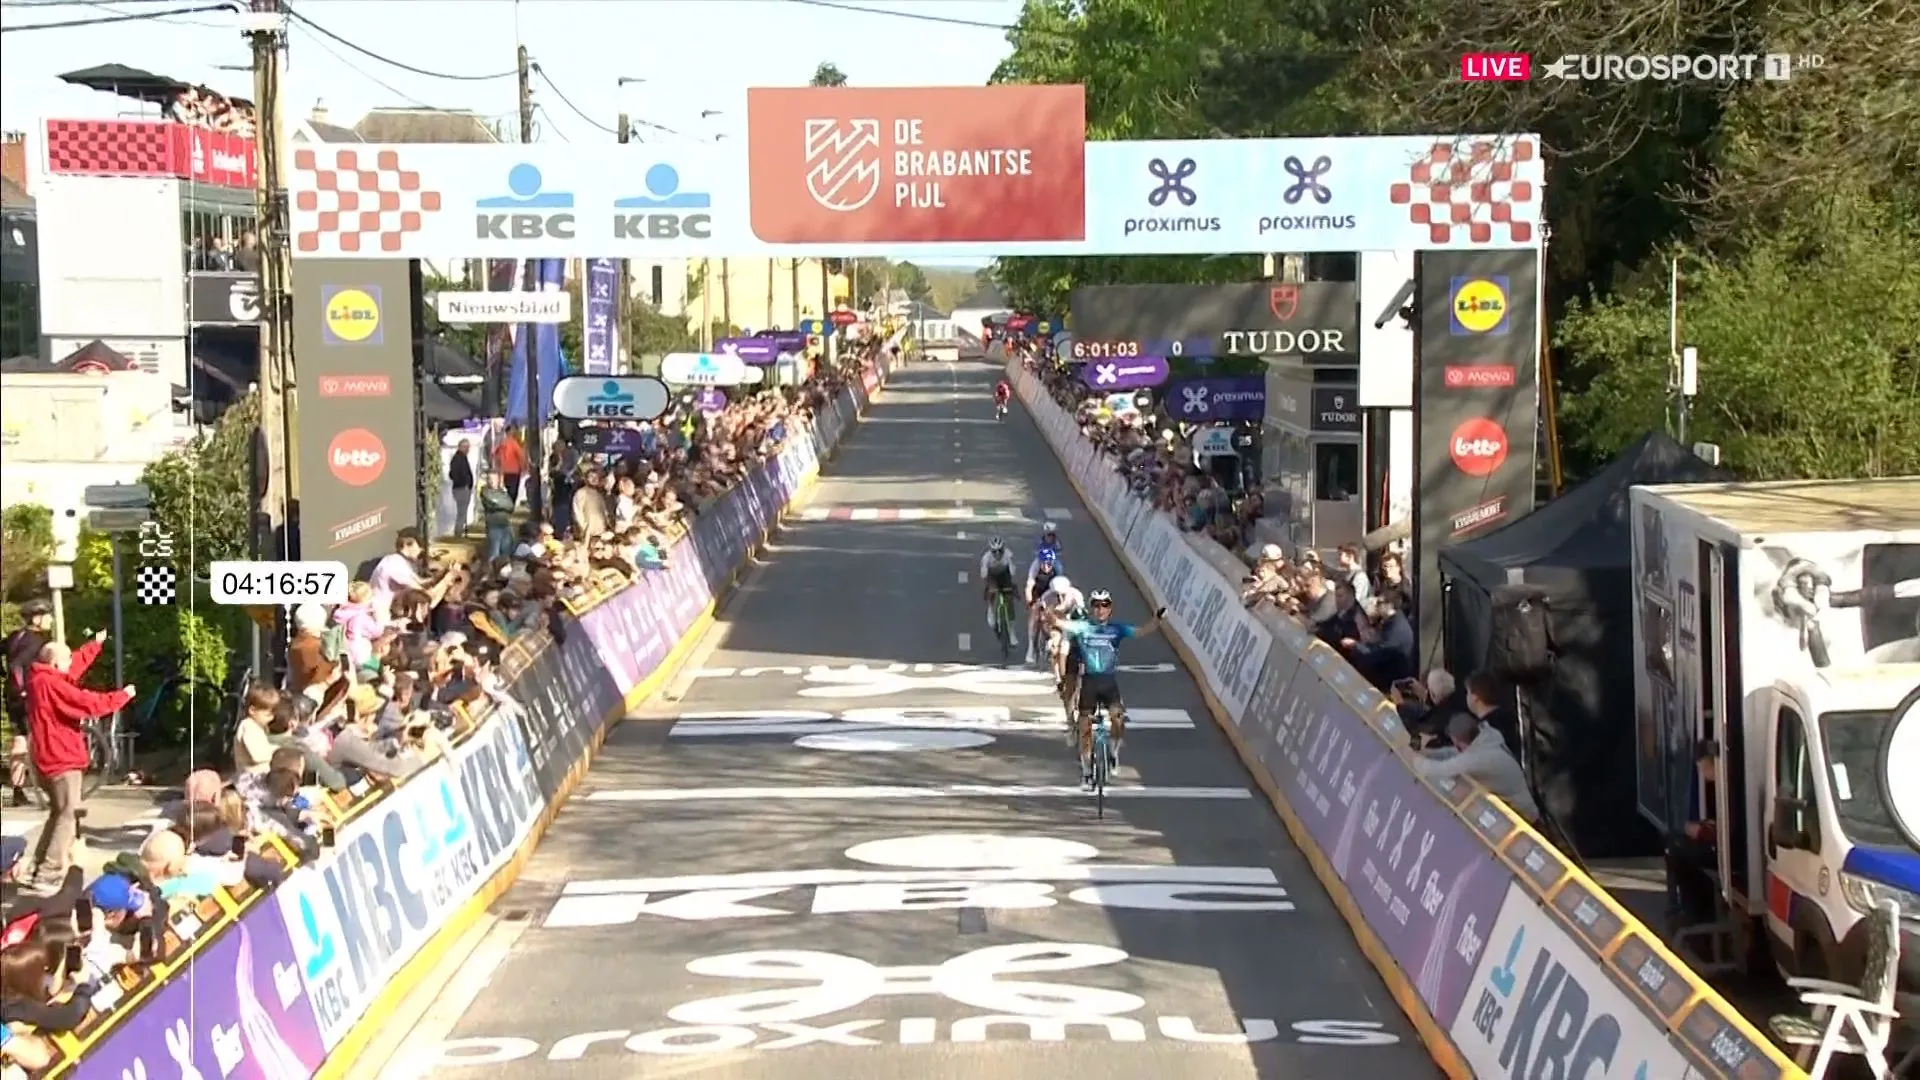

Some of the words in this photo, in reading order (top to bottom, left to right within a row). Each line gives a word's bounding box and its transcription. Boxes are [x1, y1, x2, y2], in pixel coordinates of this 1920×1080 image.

[894, 119, 923, 145] DE
[894, 149, 1033, 176] BRABANTSE
[895, 182, 946, 208] PIJL
[476, 213, 575, 239] KBC
[613, 213, 711, 239] KBC
[1124, 217, 1221, 237] proximus
[1258, 214, 1357, 235] proximus
[449, 301, 561, 316] Nieuwsblad
[1074, 342, 1138, 357] 6:01:03
[1172, 341, 1183, 356] 0
[1223, 329, 1346, 353] TUDOR
[586, 404, 635, 416] KBC
[1320, 412, 1357, 423] TUDOR
[332, 447, 382, 468] lotto
[1454, 436, 1502, 457] lotto
[323, 810, 428, 994] KBC
[543, 882, 1297, 928] KBC
[1472, 986, 1503, 1044] KBC
[436, 1017, 1401, 1066] proximus
